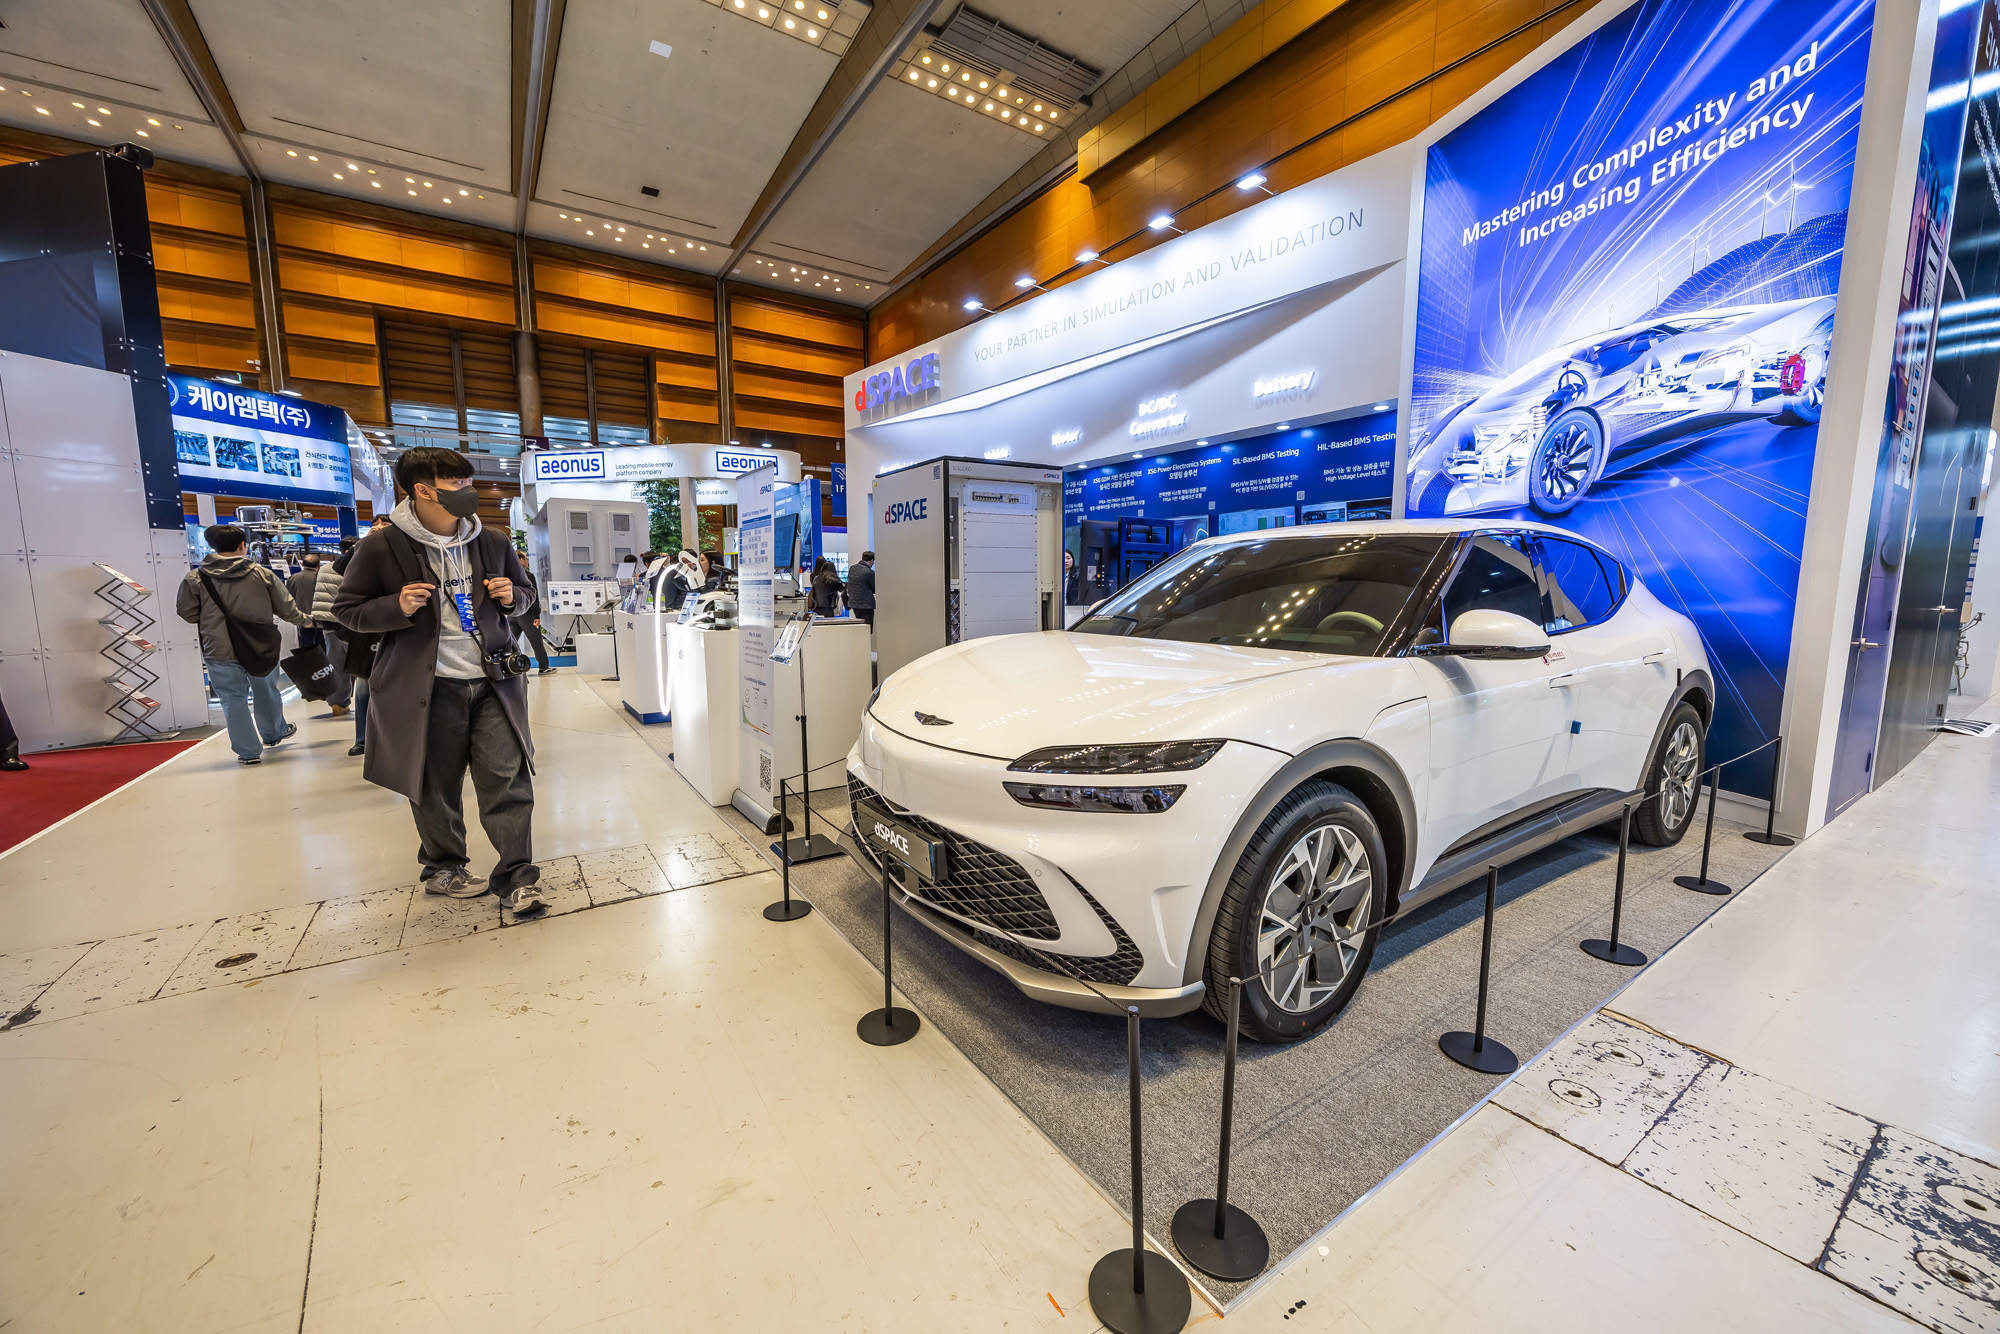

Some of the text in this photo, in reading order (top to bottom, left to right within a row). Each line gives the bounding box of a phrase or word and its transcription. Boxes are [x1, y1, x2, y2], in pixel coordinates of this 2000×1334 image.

[1462, 40, 1819, 247] Mastering Complexity and
[1518, 92, 1815, 247] Increasing Efficiency
[973, 207, 1364, 364] YOUR PARTNER IN SIMULATION AND VALIDATION
[854, 352, 939, 412] dSPACE
[1254, 371, 1314, 397] Battery
[187, 385, 311, 428] 케이엠텍(주)
[1139, 394, 1178, 416] DC/DC
[1130, 413, 1188, 436] Converter
[1052, 430, 1080, 446] Motor
[1317, 432, 1396, 451] HIL-Based BMS Testin
[541, 458, 600, 474] aeonus
[616, 464, 636, 472] Leading
[1173, 461, 1199, 471] Electronics
[1200, 458, 1222, 467] Systems
[1233, 449, 1299, 465] SIL-Based BMS Testing
[884, 498, 928, 524] dSPACE
[312, 664, 335, 681] dSPA
[875, 822, 909, 856] dSPACE
